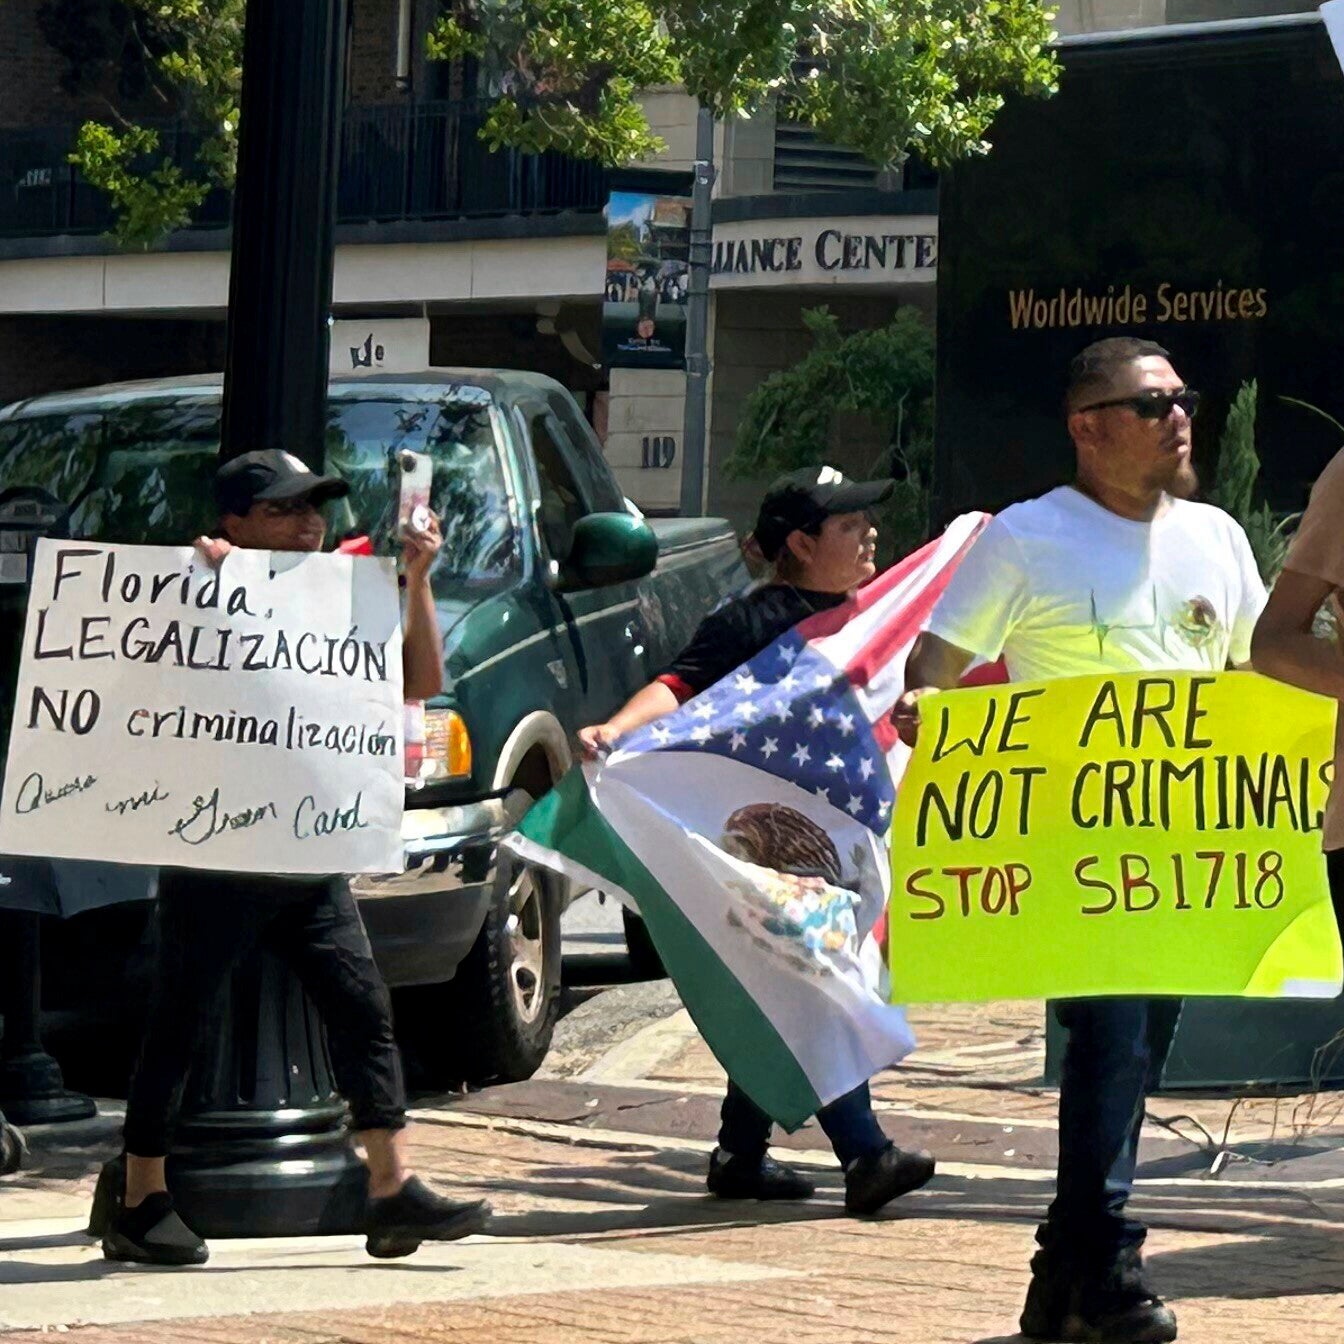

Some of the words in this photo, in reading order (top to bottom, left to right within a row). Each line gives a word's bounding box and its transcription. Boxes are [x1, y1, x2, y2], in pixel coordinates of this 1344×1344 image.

[1008, 284, 1147, 331] Worldwide
[1157, 278, 1268, 323] Services
[640, 436, 676, 469] 119
[33, 606, 390, 683] LEGALIZACIÓN
[26, 685, 101, 735] NO
[127, 705, 397, 757] criminalización
[931, 688, 1047, 764] WE
[1078, 677, 1217, 750] ARE
[294, 791, 369, 840] Card
[916, 766, 1047, 847] NOT
[905, 862, 1032, 920] STOP
[1074, 849, 1285, 915] SB1718
